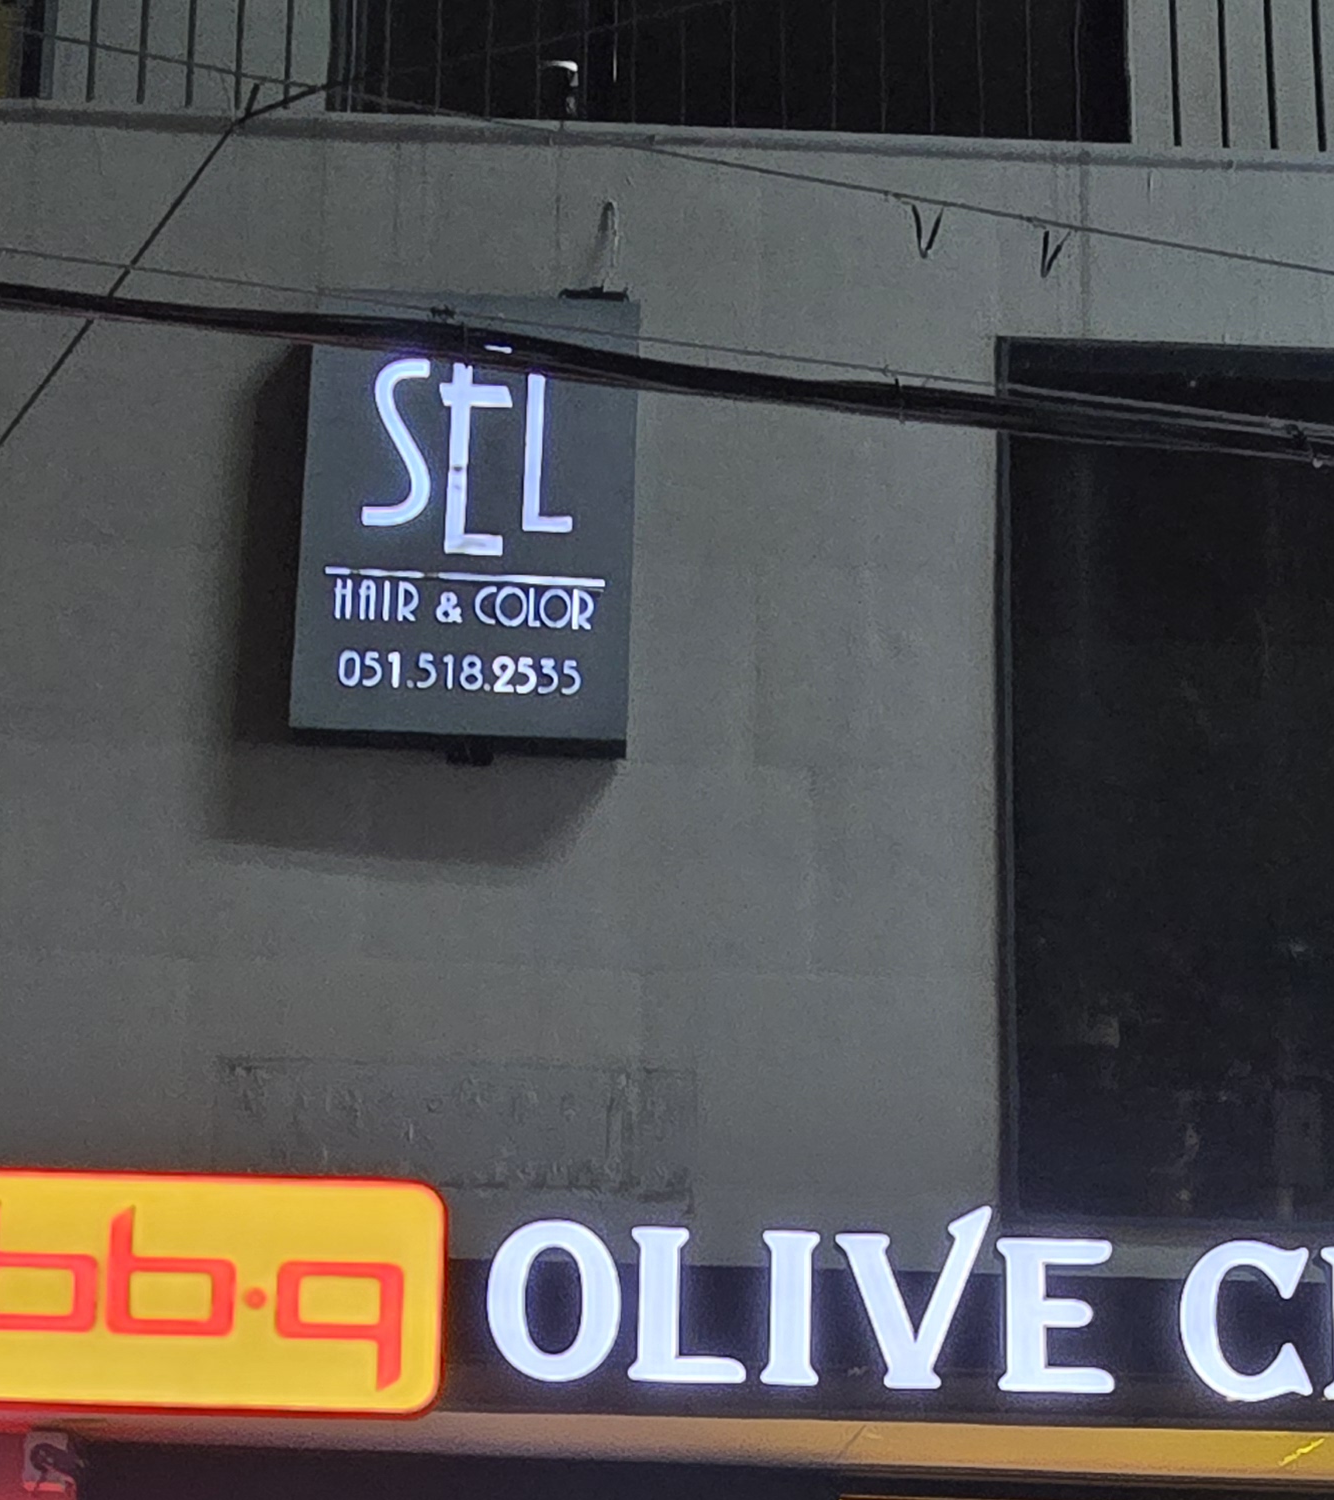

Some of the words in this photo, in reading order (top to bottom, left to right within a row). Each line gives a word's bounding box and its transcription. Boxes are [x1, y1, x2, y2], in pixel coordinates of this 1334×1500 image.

[334, 579, 419, 622] HAIR
[435, 592, 463, 624] &
[474, 586, 595, 631] COLOR
[338, 649, 583, 696] 051.518.2535
[489, 1207, 1113, 1392] OLIVE
